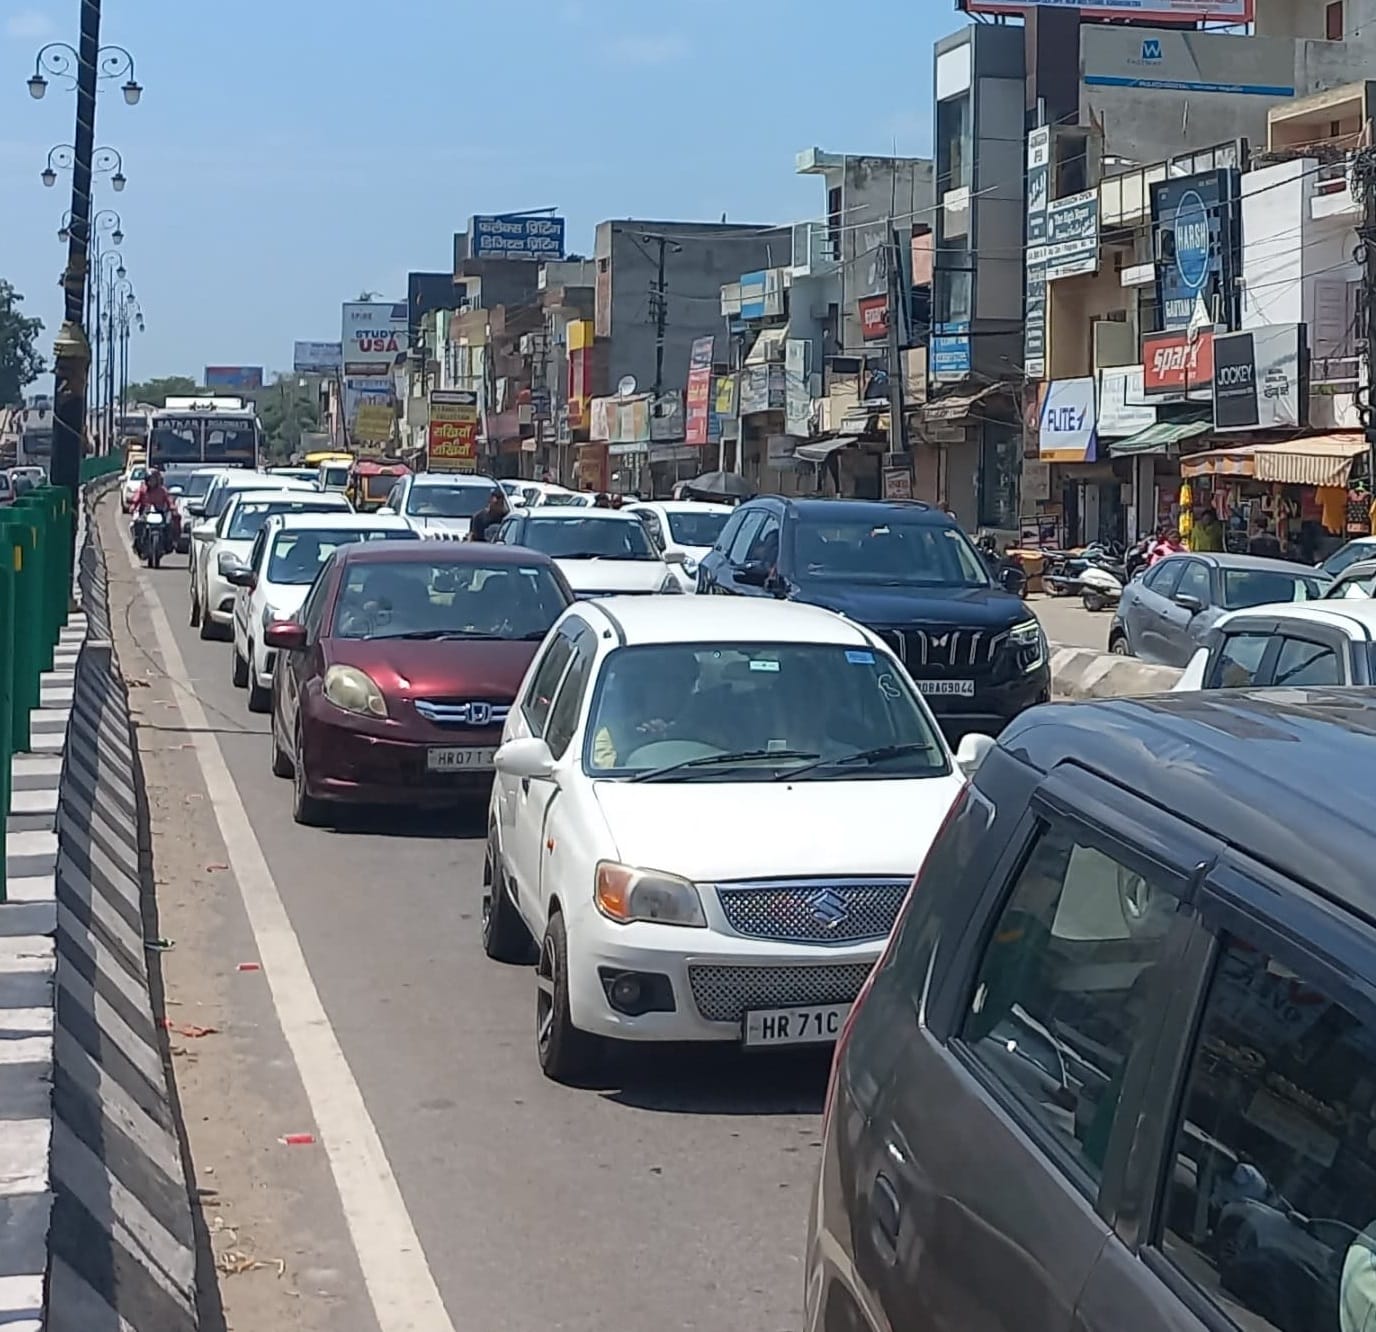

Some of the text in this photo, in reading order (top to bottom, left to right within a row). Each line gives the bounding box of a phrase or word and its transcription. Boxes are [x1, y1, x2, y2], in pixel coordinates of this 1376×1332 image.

[1177, 222, 1206, 252] HARSH
[356, 330, 395, 339] STUDY
[359, 339, 399, 352] USA
[1218, 364, 1253, 386] JOCKEY
[1048, 407, 1075, 431] FLITE
[438, 751, 472, 766] HR07
[762, 1011, 838, 1039] HR 71C
